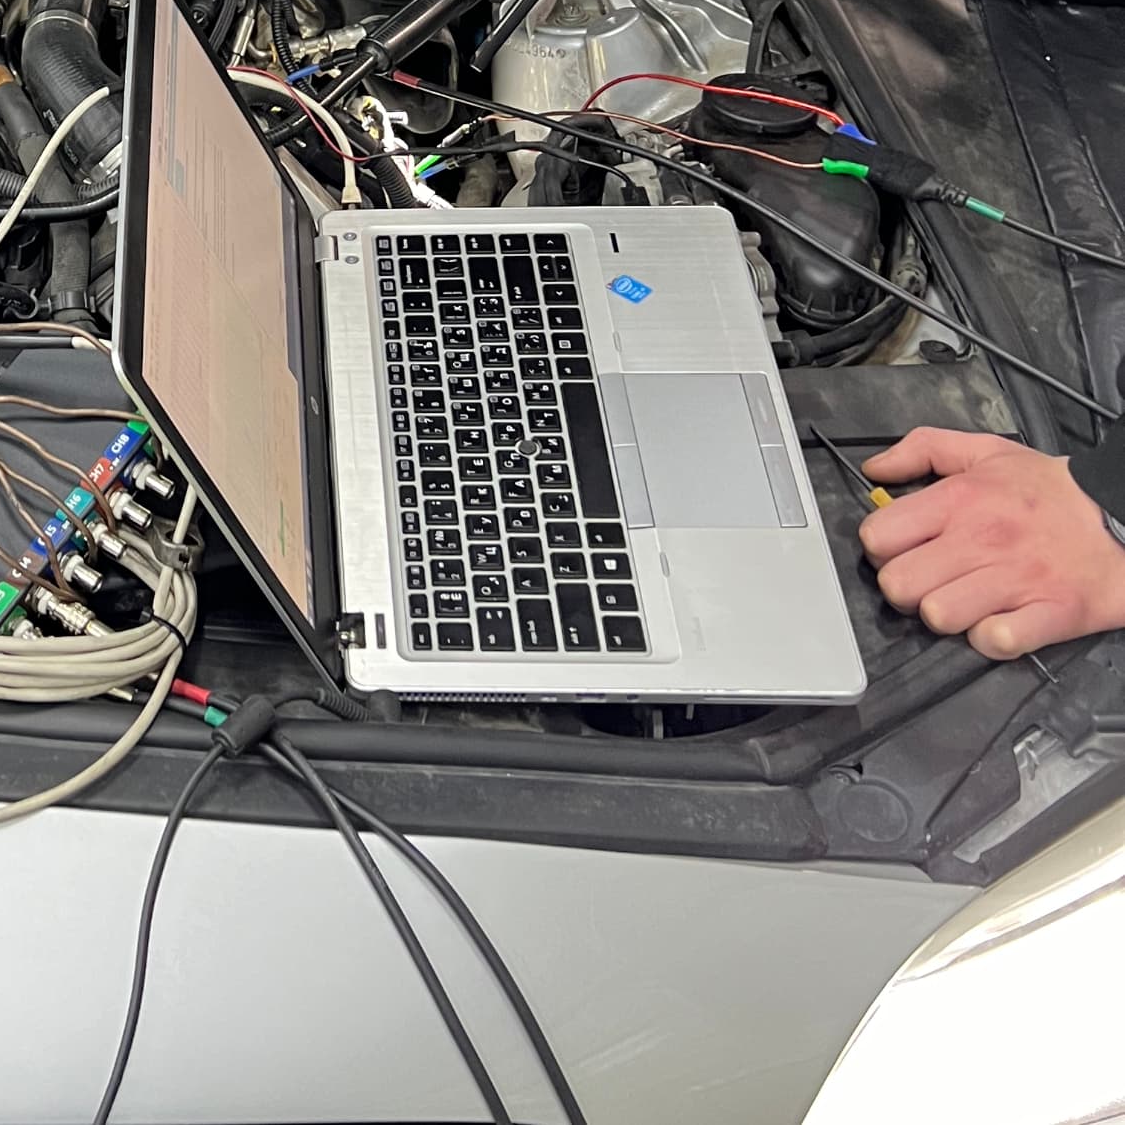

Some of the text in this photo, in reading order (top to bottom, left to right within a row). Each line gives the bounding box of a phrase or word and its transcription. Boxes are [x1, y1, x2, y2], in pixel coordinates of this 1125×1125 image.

[111, 434, 130, 454] CH8
[88, 463, 104, 482] H7
[66, 494, 82, 510] H6
